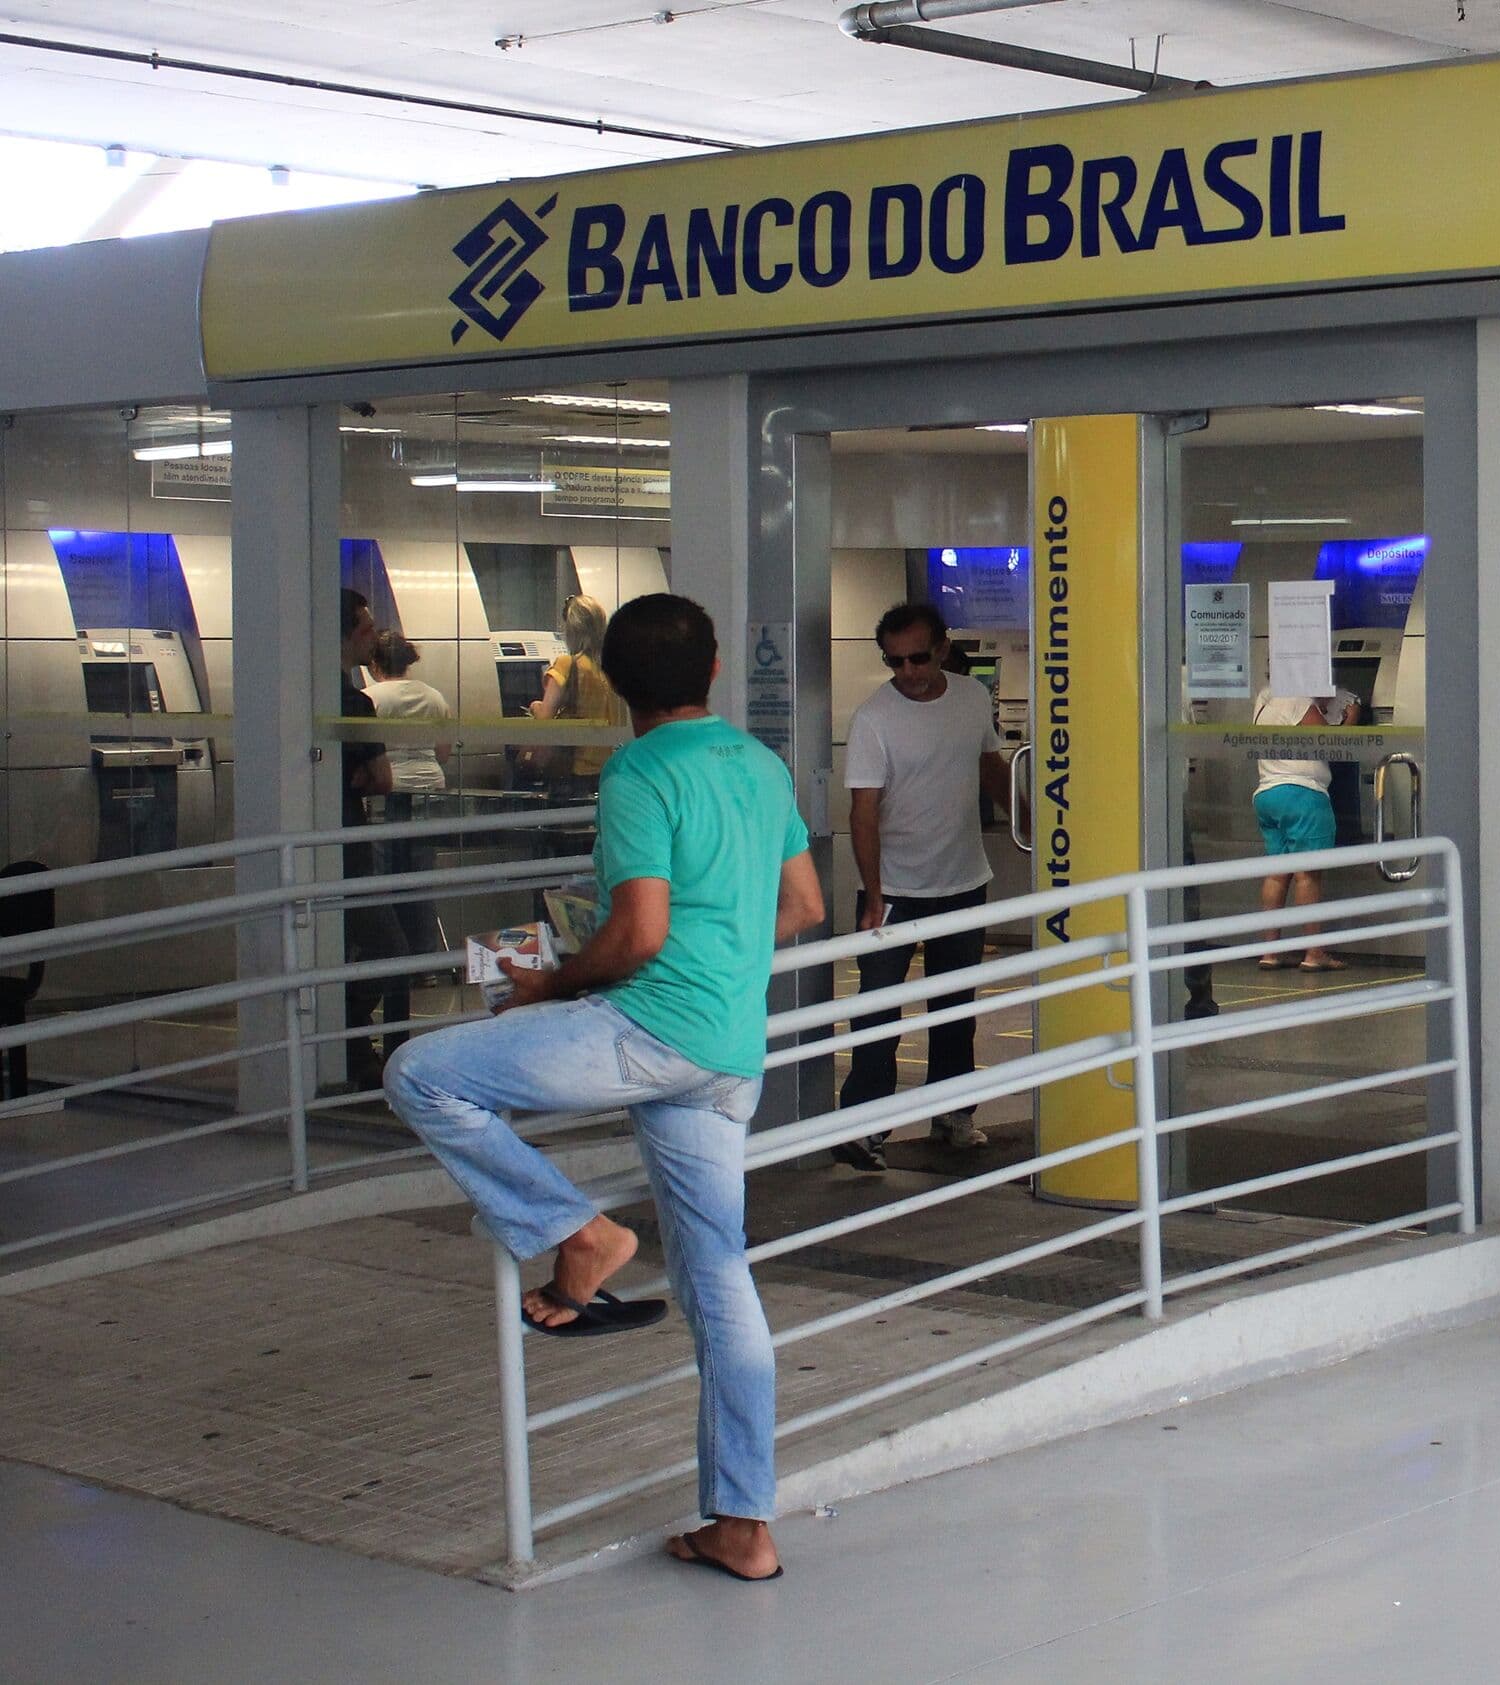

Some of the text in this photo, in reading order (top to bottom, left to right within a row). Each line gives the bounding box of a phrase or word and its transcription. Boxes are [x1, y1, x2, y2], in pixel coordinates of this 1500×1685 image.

[568, 130, 1347, 312] BANCO DO BRASIL
[1367, 546, 1423, 560] Depósitos
[1190, 610, 1245, 620] Comunicado
[1199, 634, 1238, 643] 10/02/2017
[1223, 733, 1384, 748] Agência Espaço Cultural PB
